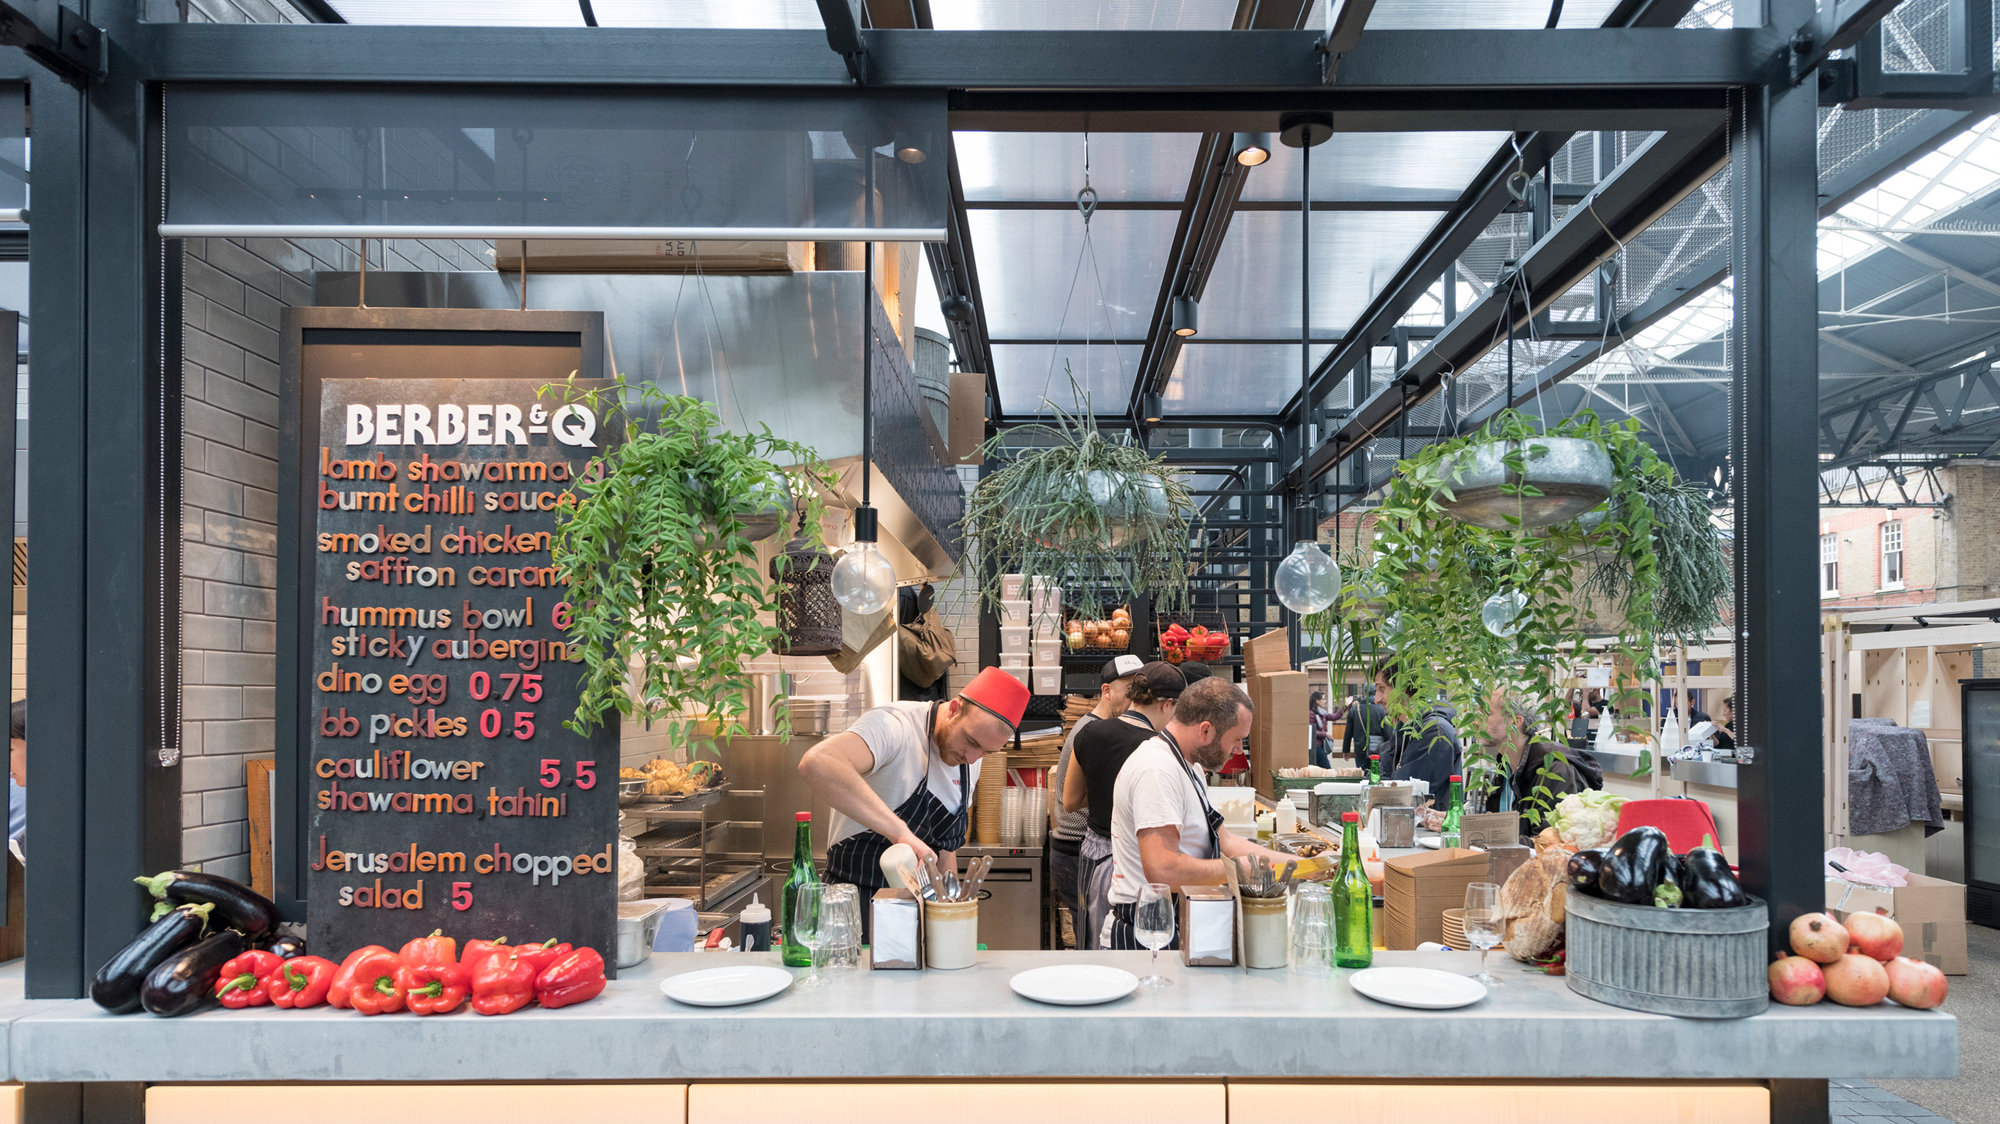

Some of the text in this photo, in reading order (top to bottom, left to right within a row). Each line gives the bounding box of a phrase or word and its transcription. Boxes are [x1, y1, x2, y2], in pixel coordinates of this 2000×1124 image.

[322, 447, 397, 481] lamb
[407, 453, 570, 482] shawarma
[319, 480, 399, 512] burnt
[403, 484, 475, 515] chilli
[318, 525, 552, 554] smoked chicken
[346, 556, 456, 587] saffron
[322, 597, 452, 629] hummus
[462, 597, 533, 630] bowl
[331, 628, 425, 667] sticky
[317, 663, 383, 694] dino
[388, 673, 448, 705] egg
[319, 707, 361, 737] bb
[369, 708, 468, 743] pickles
[315, 750, 485, 781] cauliflower
[487, 787, 568, 817] tahini
[474, 843, 612, 886] chopped
[338, 878, 473, 911] salad 5
